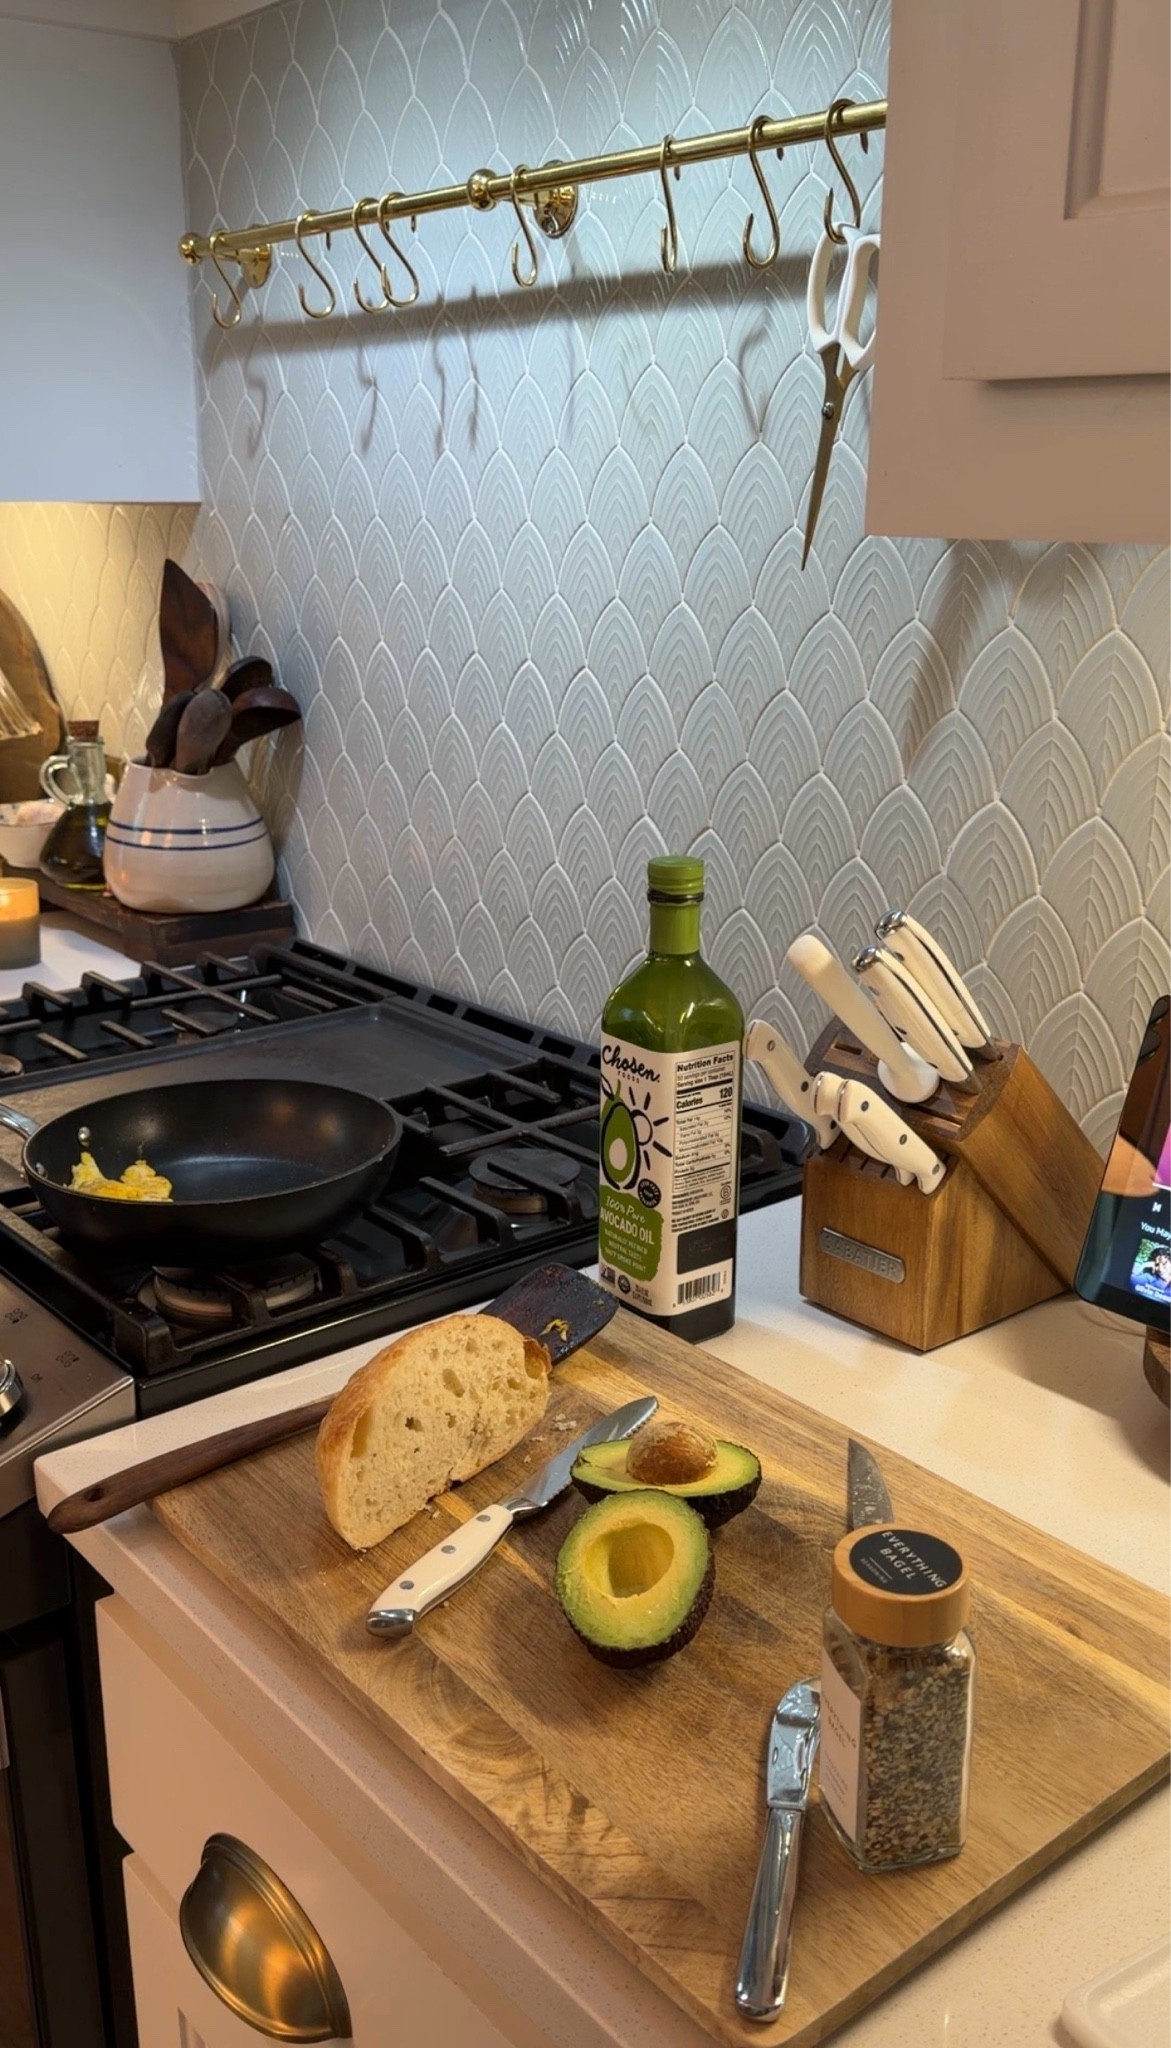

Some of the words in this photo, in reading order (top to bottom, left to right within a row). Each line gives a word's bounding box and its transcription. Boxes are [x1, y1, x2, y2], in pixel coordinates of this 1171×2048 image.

[602, 1044, 660, 1082] Chosen
[677, 1060, 711, 1072] Nutrition
[713, 1054, 733, 1065] Facts
[677, 1097, 703, 1109] Calories
[719, 1087, 732, 1099] 120
[606, 1195, 626, 1214] 100%
[626, 1205, 646, 1224] Pure
[600, 1206, 638, 1238] AVOCADO
[639, 1227, 655, 1245] OIL
[1141, 1221, 1155, 1234] You
[880, 1548, 916, 1580] BAGEL
[881, 1531, 947, 1588] EVERYTHING
